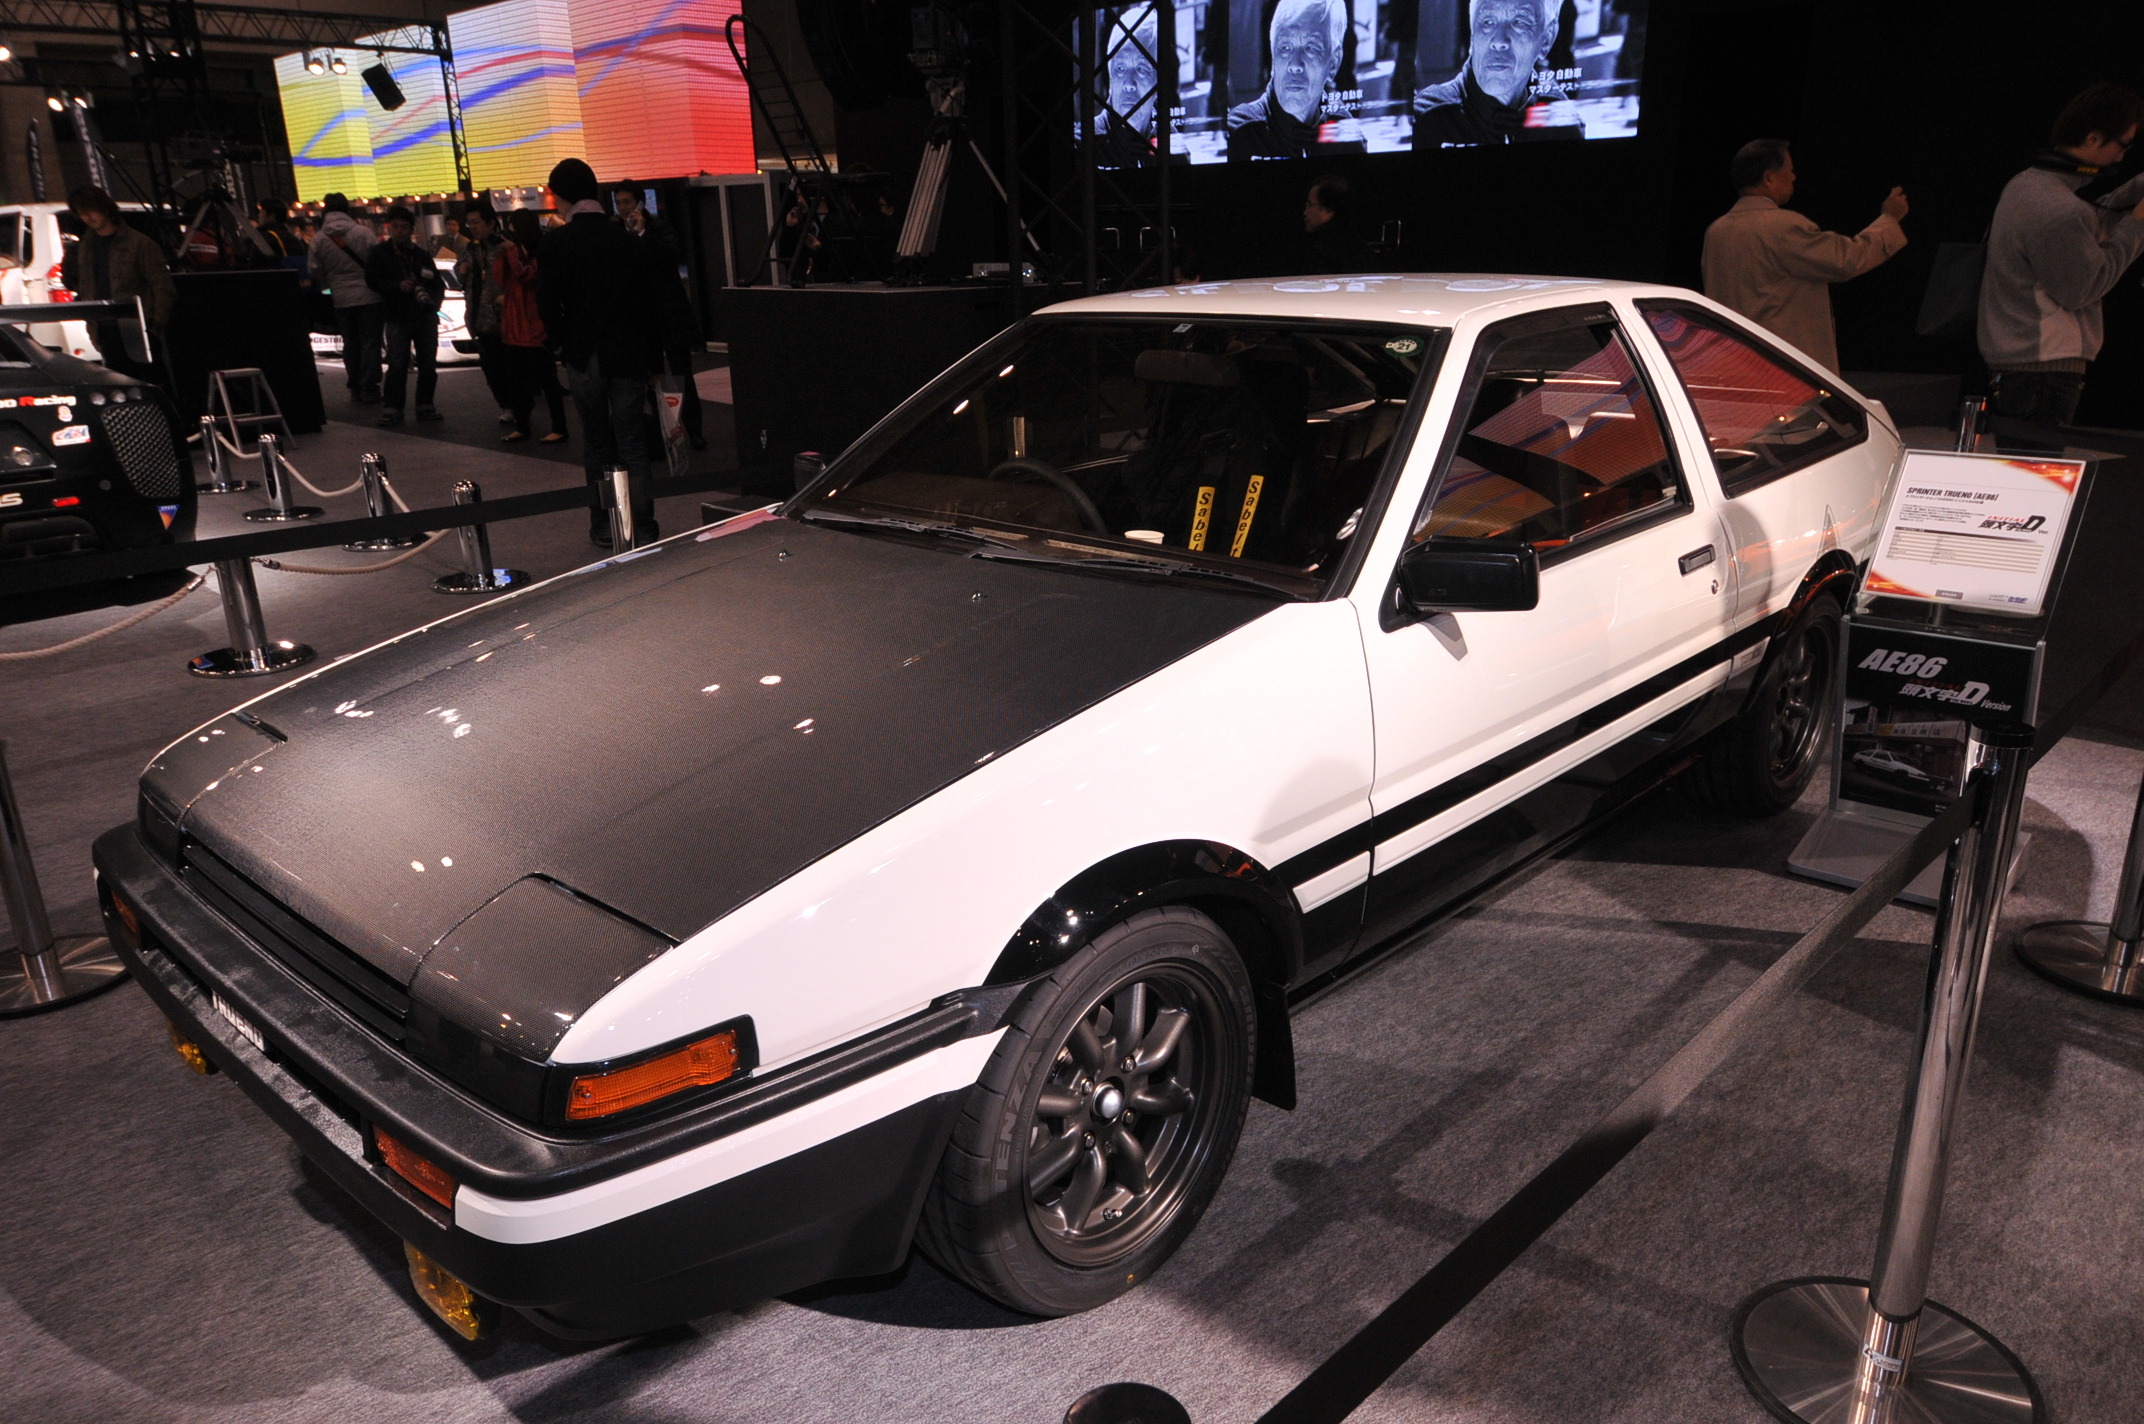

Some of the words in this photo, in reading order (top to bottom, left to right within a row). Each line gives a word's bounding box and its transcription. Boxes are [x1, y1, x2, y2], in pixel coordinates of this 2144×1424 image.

[1531, 67, 1583, 82] トヨタ自動車
[1321, 88, 1364, 102] トヨタ自動車
[1396, 342, 1411, 351] 21
[19, 394, 77, 407] Racing
[1907, 487, 1942, 497] SPRINTER
[1944, 490, 1973, 499] TRUENO
[1973, 492, 2000, 502] [AE86]
[1231, 480, 1260, 557] Sabelt
[1987, 514, 2026, 523] INITIAL
[1857, 648, 1948, 679] AE86
[1980, 699, 2012, 712] Version
